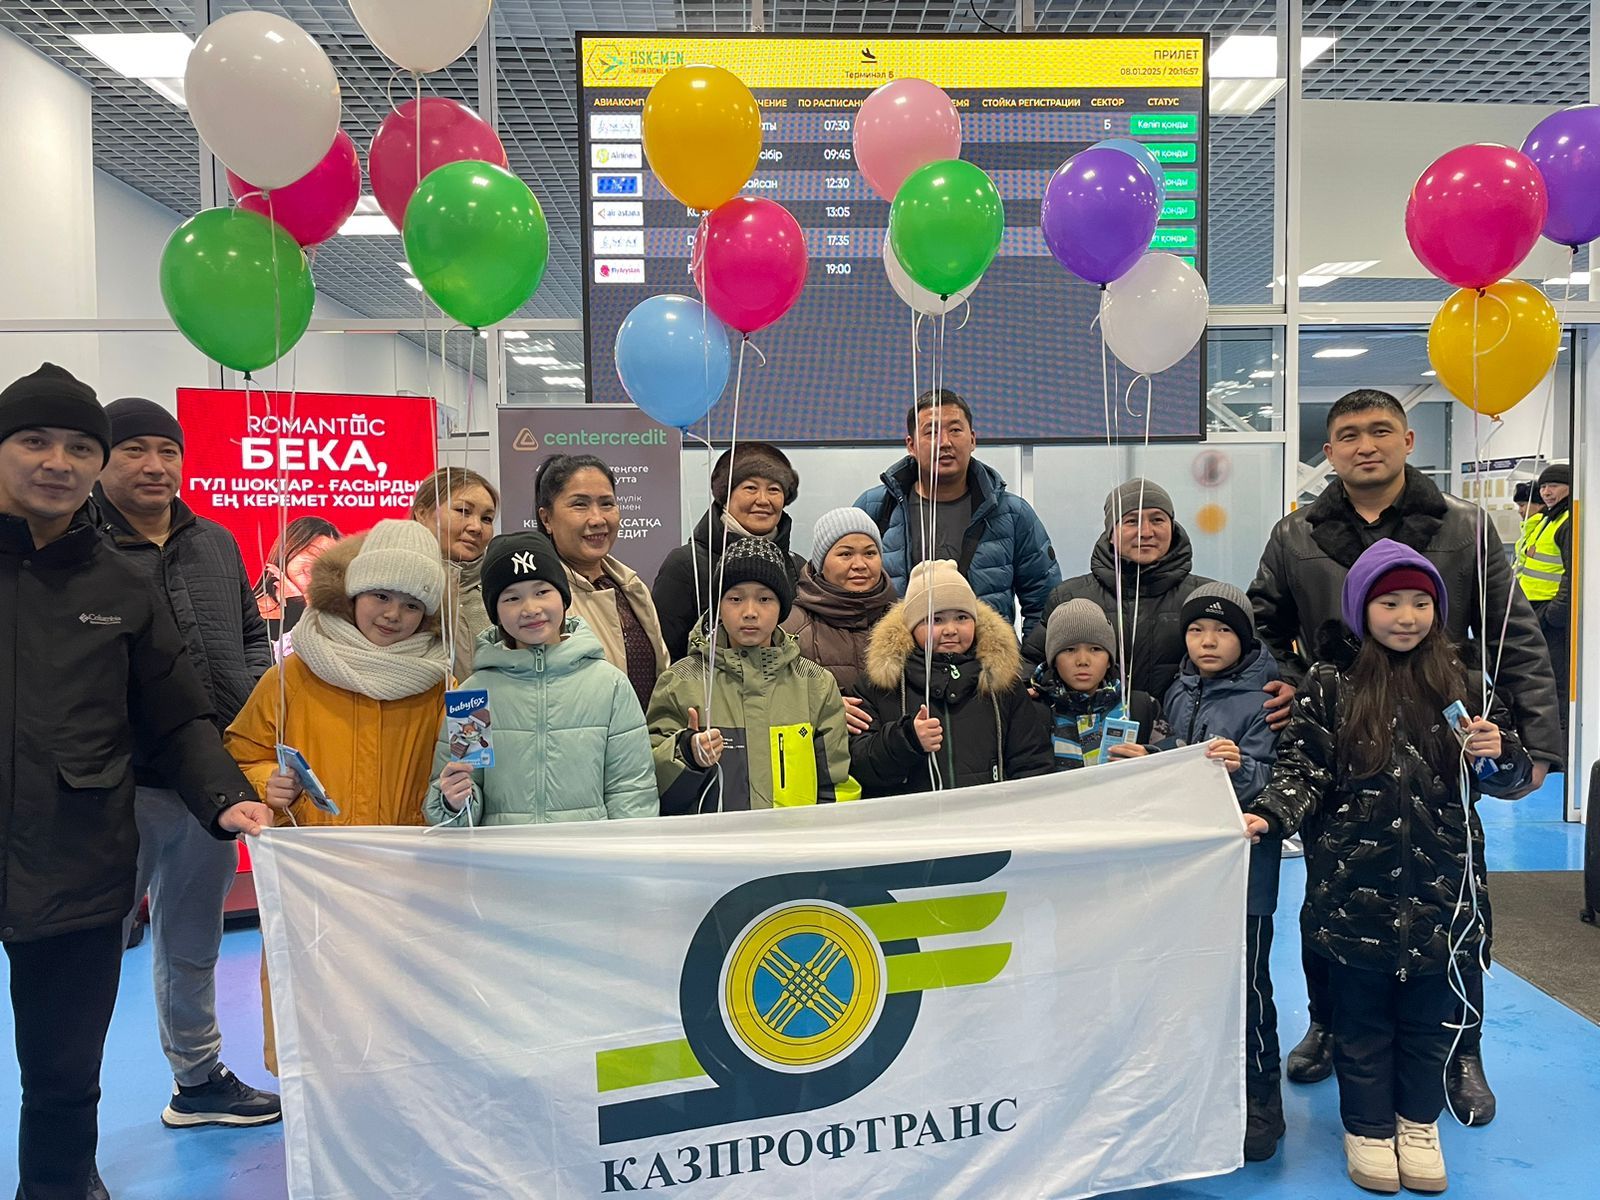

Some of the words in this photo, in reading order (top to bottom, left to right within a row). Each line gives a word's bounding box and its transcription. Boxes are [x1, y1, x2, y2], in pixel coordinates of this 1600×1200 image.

[1154, 50, 1199, 60] ПРИЛЕТ
[845, 70, 886, 79] Терминал
[593, 98, 646, 107] АВИАКОМП
[757, 98, 788, 108] ЧЕНИЕ
[798, 99, 812, 108] ПО
[813, 99, 865, 108] РАСПИСАН
[952, 99, 970, 108] ЕМЯ
[982, 97, 1017, 108] СТОЙКА
[1018, 98, 1081, 109] РЕГИСТРАЦИИ
[1090, 98, 1125, 107] СЕКТОР
[1147, 98, 1180, 107] СТАТУС
[761, 122, 778, 131] аты
[824, 120, 850, 131] 07:30
[1103, 119, 1112, 130] Б
[759, 148, 783, 162] сібір
[823, 148, 851, 160] 09:45
[825, 177, 850, 189] 12:30
[1165, 179, 1189, 188] онды
[825, 206, 850, 217] 13:05
[827, 234, 850, 246] 17:35
[825, 263, 852, 274] 19:00
[543, 429, 668, 446] centercredit
[241, 436, 389, 478] БЕКА,
[189, 477, 226, 491] ГҮЛ
[231, 477, 314, 494] ШОҚТАР
[328, 478, 424, 494] ҒАСЫРДЫ
[614, 475, 638, 486] утта
[211, 493, 240, 509] ЕҢ
[243, 493, 329, 508] КЕРЕМЕТ
[332, 493, 376, 508] ХОШ
[616, 529, 649, 540] ЕДИТ
[449, 695, 485, 714] babyfox
[600, 1097, 1019, 1194] КАЗПРОФТРАНС
